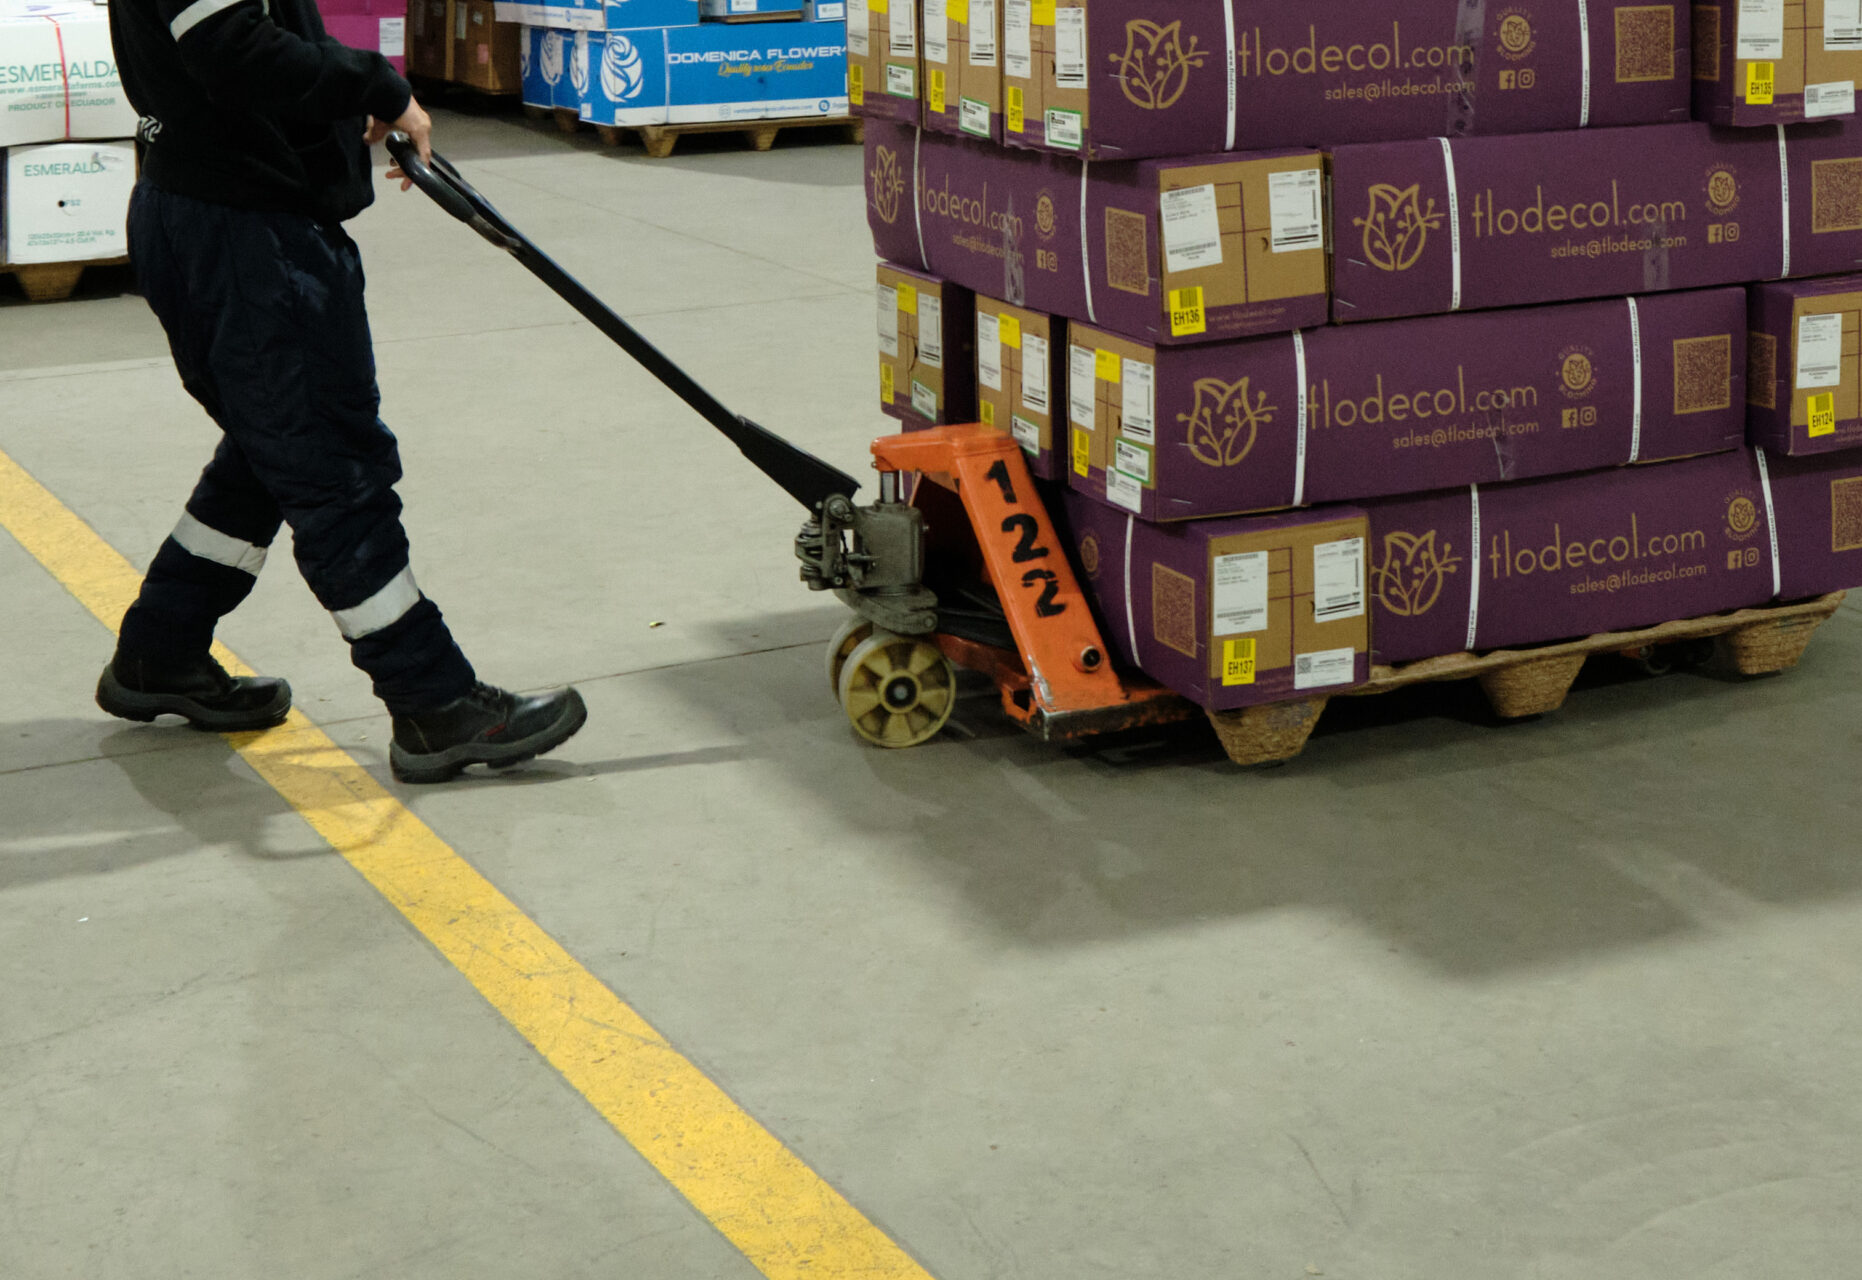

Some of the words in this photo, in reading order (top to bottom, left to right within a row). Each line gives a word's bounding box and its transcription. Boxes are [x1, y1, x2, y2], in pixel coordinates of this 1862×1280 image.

[668, 50, 761, 64] DOMENICA
[767, 46, 846, 60] FLOWER'
[1238, 20, 1475, 77] flodecol.com
[24, 161, 104, 177] ESMERALD
[1472, 178, 1686, 237] flodecol.com
[1173, 308, 1200, 326] EH136
[1307, 364, 1538, 430] flodecol.com
[1812, 411, 1833, 428] EH124
[1488, 512, 1705, 579] flodecol.com
[1570, 562, 1707, 595] sales@flodecol.com
[1227, 659, 1255, 676] EH137
